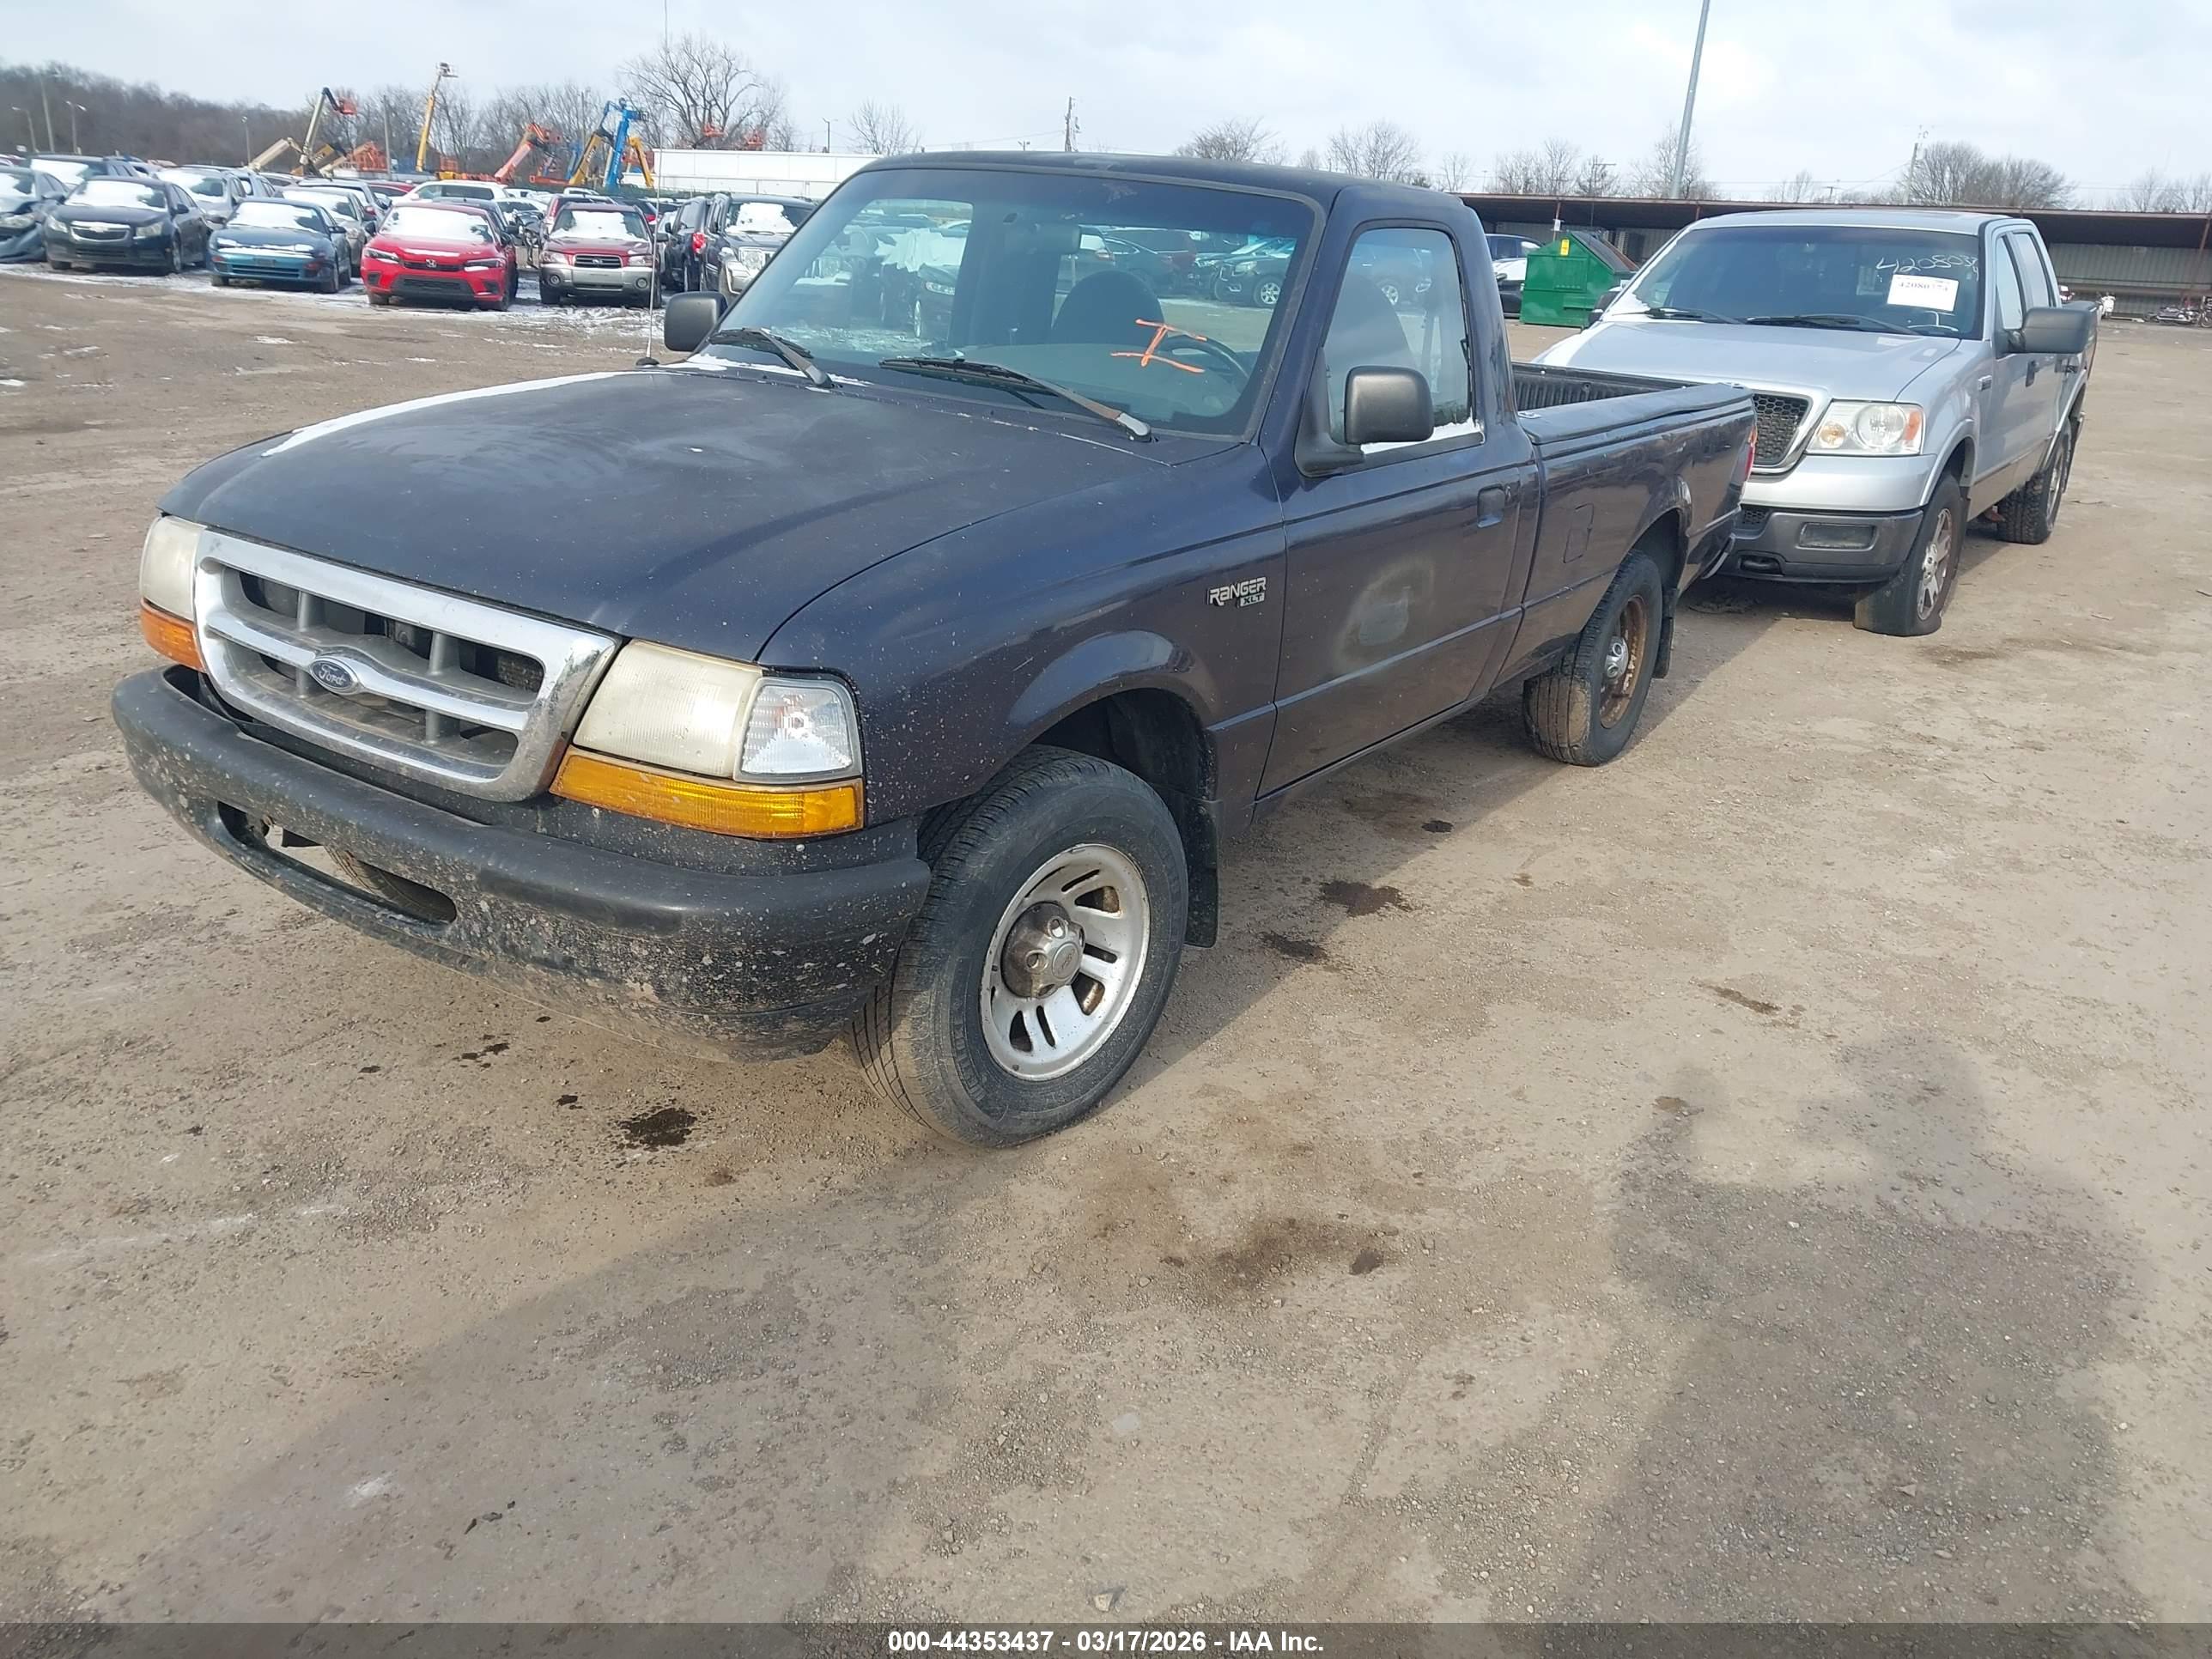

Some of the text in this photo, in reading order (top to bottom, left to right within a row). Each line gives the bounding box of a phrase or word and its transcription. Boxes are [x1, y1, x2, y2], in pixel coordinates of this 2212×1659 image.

[1208, 576, 1267, 606] RANGER
[1243, 593, 1263, 605] XLT
[319, 664, 347, 686] Ford
